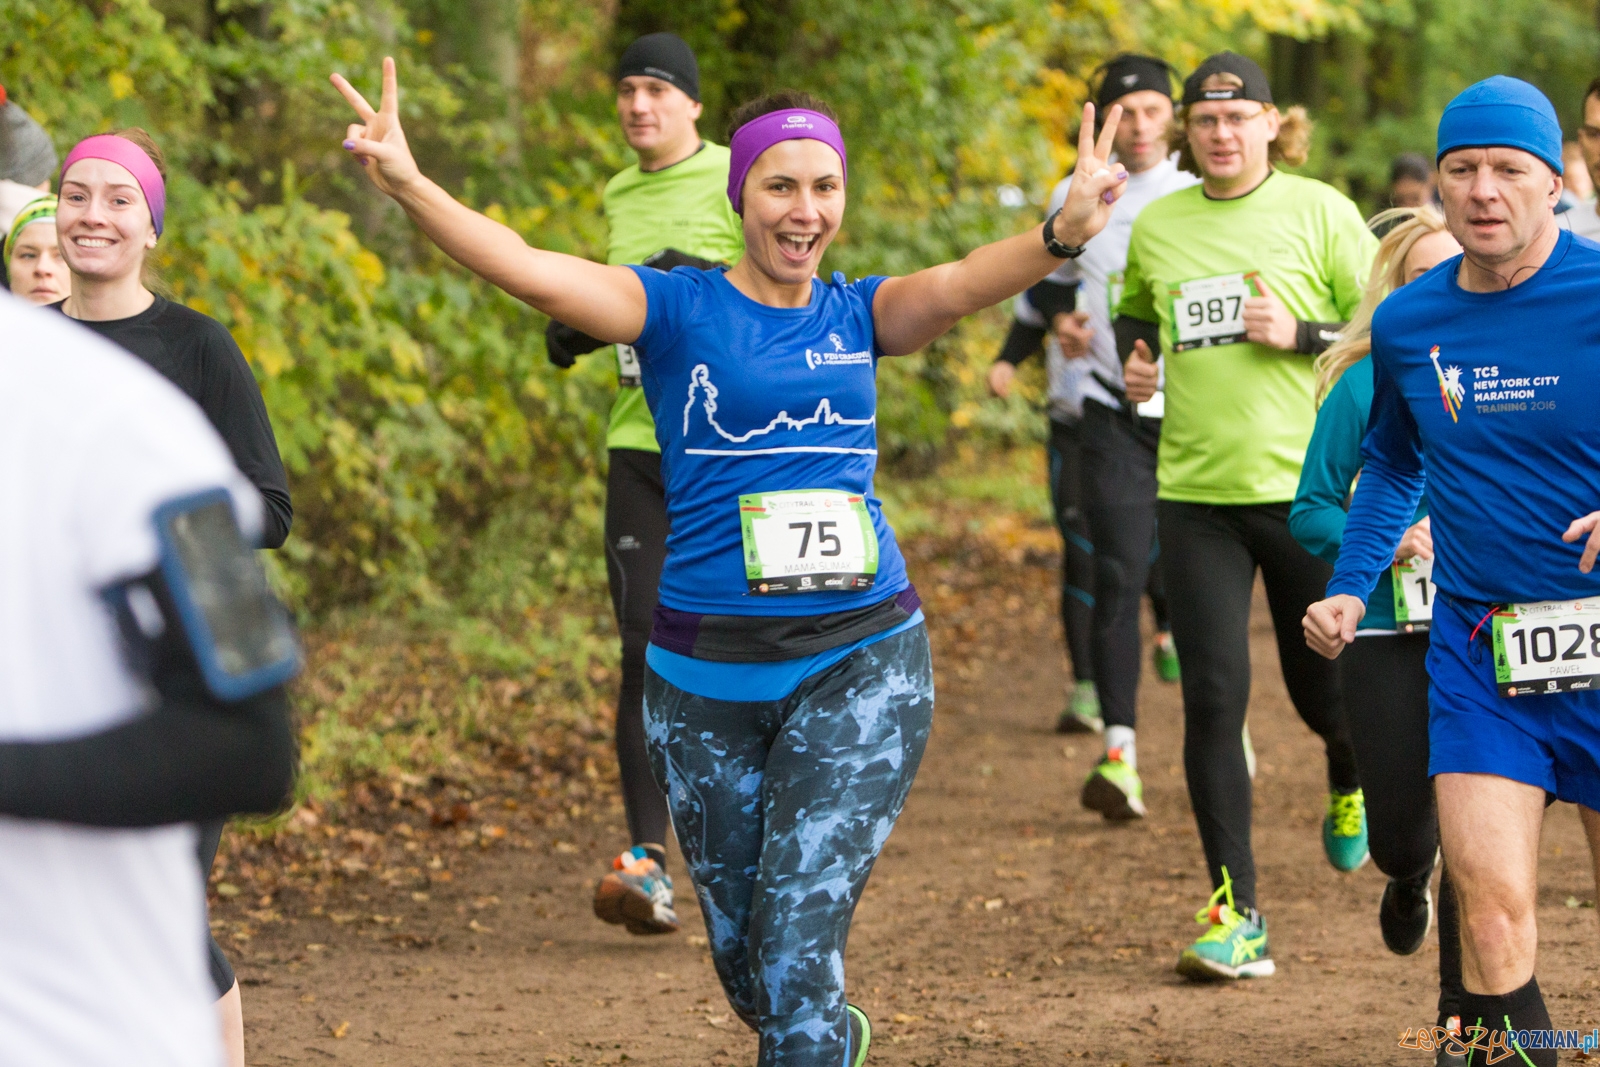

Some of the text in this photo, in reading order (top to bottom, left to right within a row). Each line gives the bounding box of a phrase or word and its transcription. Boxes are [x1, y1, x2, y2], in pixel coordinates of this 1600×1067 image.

[1188, 295, 1242, 327] 987
[1473, 366, 1499, 379] TCS
[1473, 376, 1560, 390] NEW YORK CITY
[1474, 389, 1535, 402] MARATHON
[1476, 400, 1556, 414] TRAINING 2016
[788, 521, 841, 558] 75
[784, 562, 817, 574] MAMA
[1549, 664, 1583, 675] PAWEŁ
